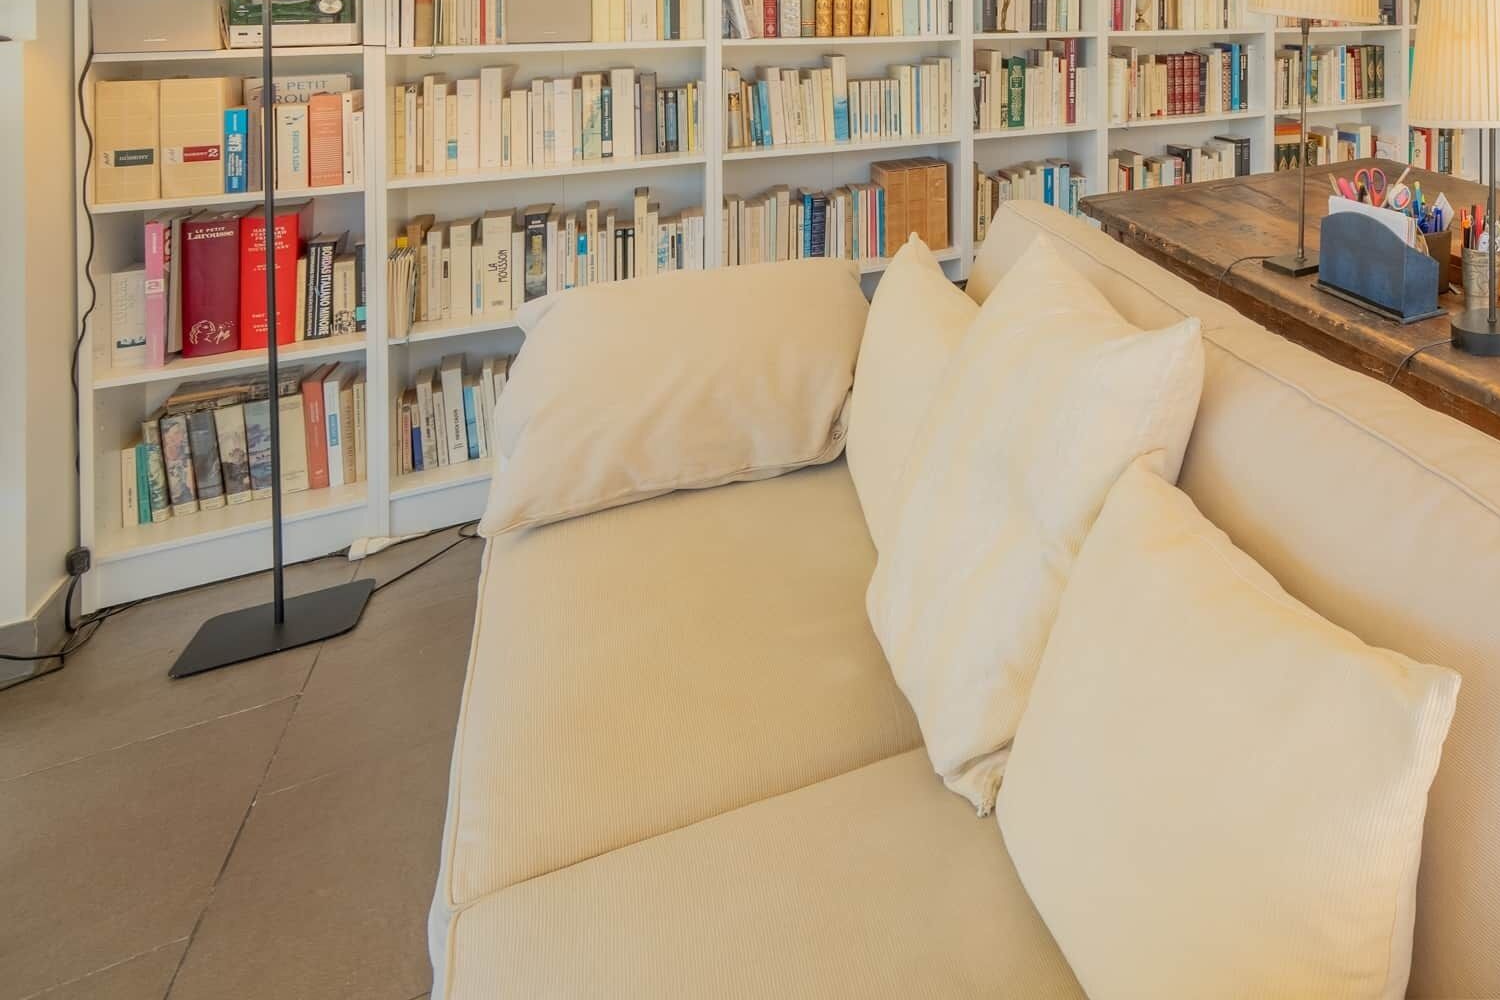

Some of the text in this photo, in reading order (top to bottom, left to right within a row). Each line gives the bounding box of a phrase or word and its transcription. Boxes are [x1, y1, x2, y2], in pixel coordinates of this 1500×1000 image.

[287, 79, 328, 91] PETIT
[187, 229, 234, 240] Larousse
[488, 263, 497, 272] LA
[497, 249, 508, 283] MOUSSON
[318, 245, 332, 335] BORDAS ITALIANO MINORE
